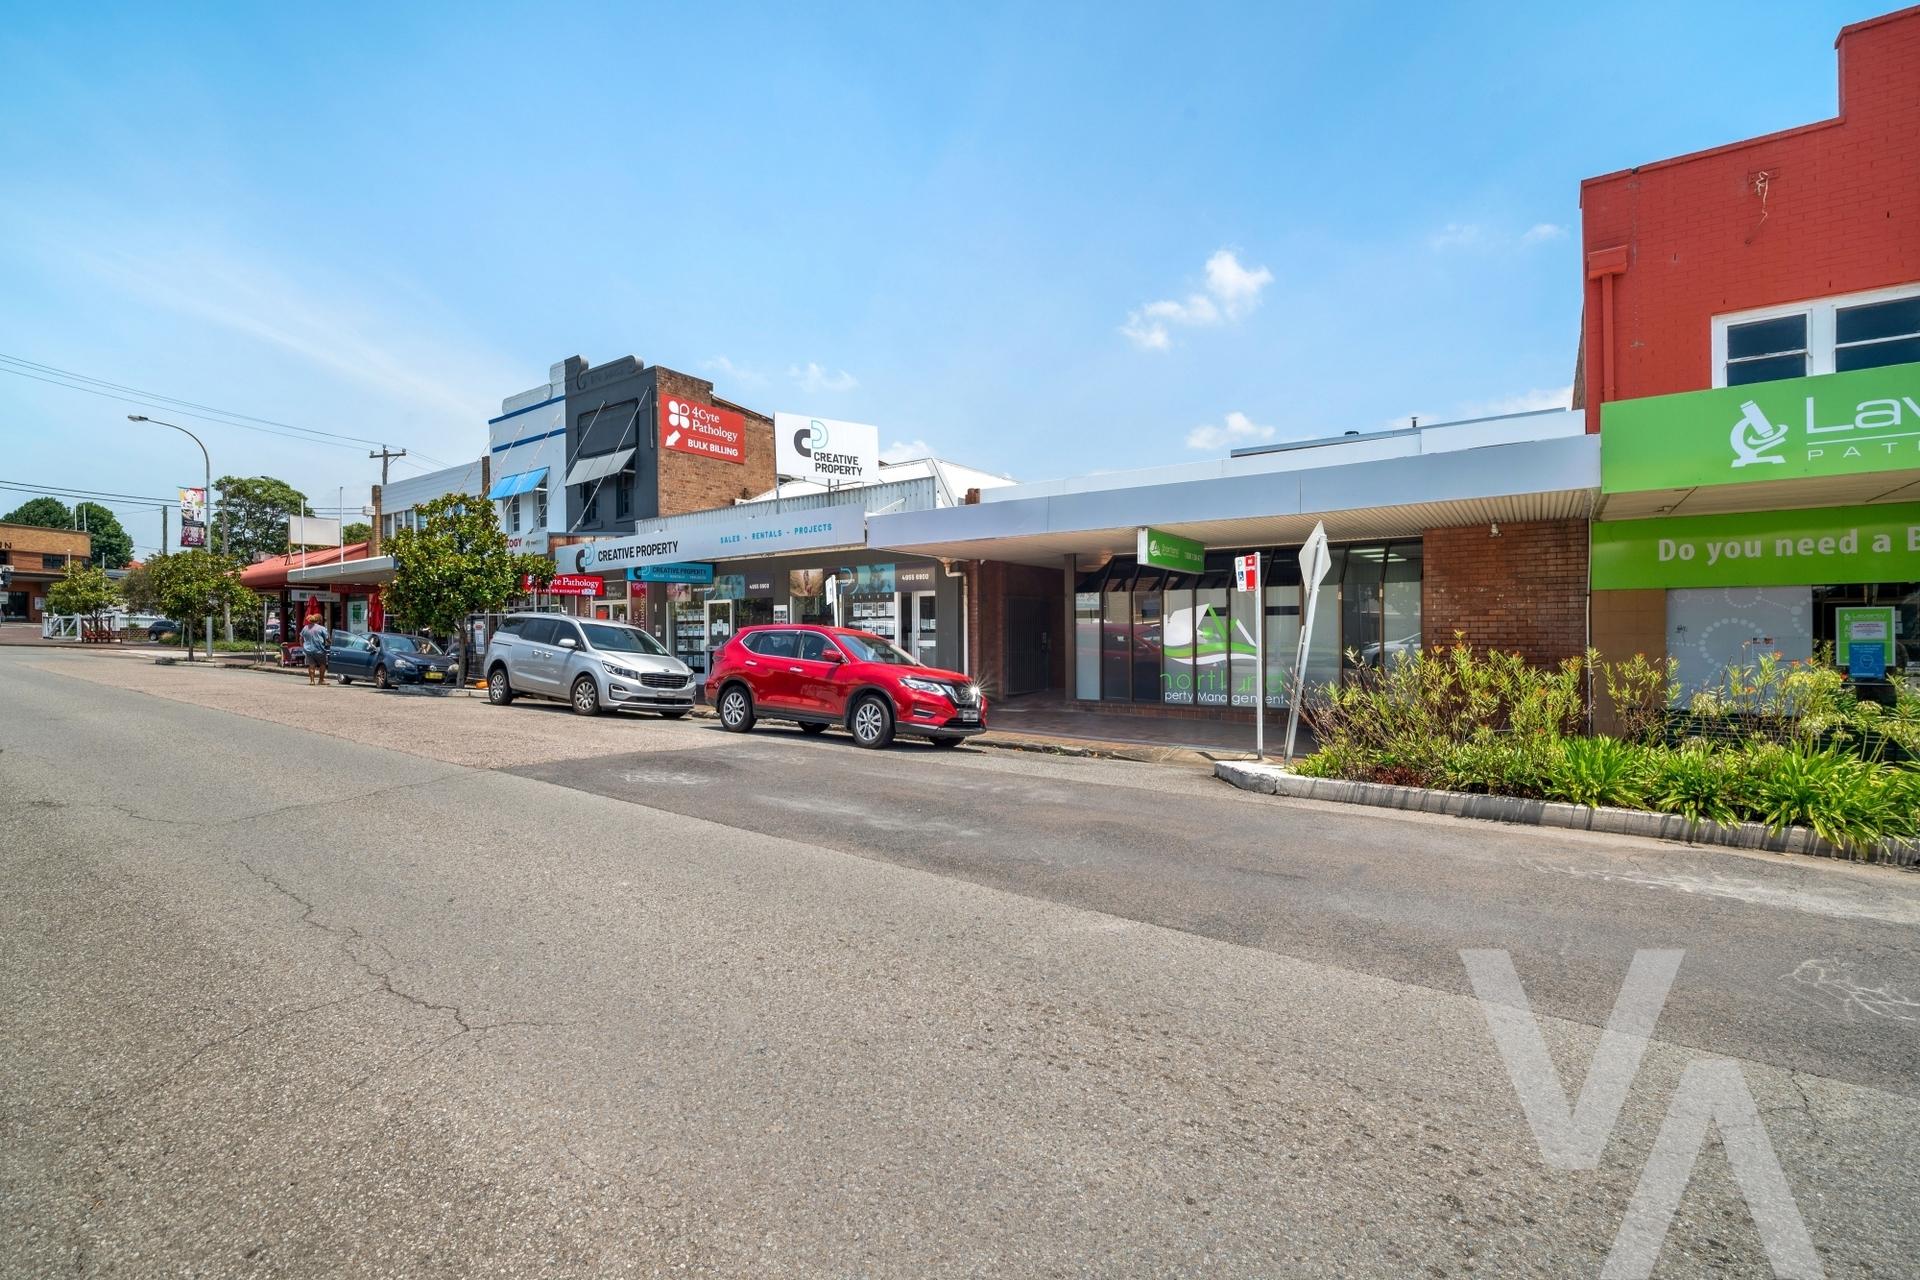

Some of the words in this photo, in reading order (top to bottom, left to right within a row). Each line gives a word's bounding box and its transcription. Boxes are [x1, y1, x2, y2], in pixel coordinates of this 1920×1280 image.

[691, 406, 720, 424] 4Cyte
[692, 419, 738, 442] Pathology
[687, 438, 708, 451] BULK
[709, 443, 738, 456] BILLING
[1808, 440, 1920, 461] PAT
[814, 452, 859, 466] CREATIVE
[815, 462, 863, 476] PROPERTY
[720, 535, 740, 544] SALES
[752, 530, 782, 540] RENTALS
[794, 523, 833, 535] PROJECTS
[597, 546, 635, 562] CREATIVE
[636, 540, 679, 557] PROPERTY
[1658, 538, 1695, 561] Do
[1706, 539, 1761, 566] you
[1775, 528, 1858, 557] need
[1871, 533, 1891, 553] a
[549, 578, 561, 587] yte
[562, 577, 599, 589] Pathology
[1164, 691, 1193, 703] perty
